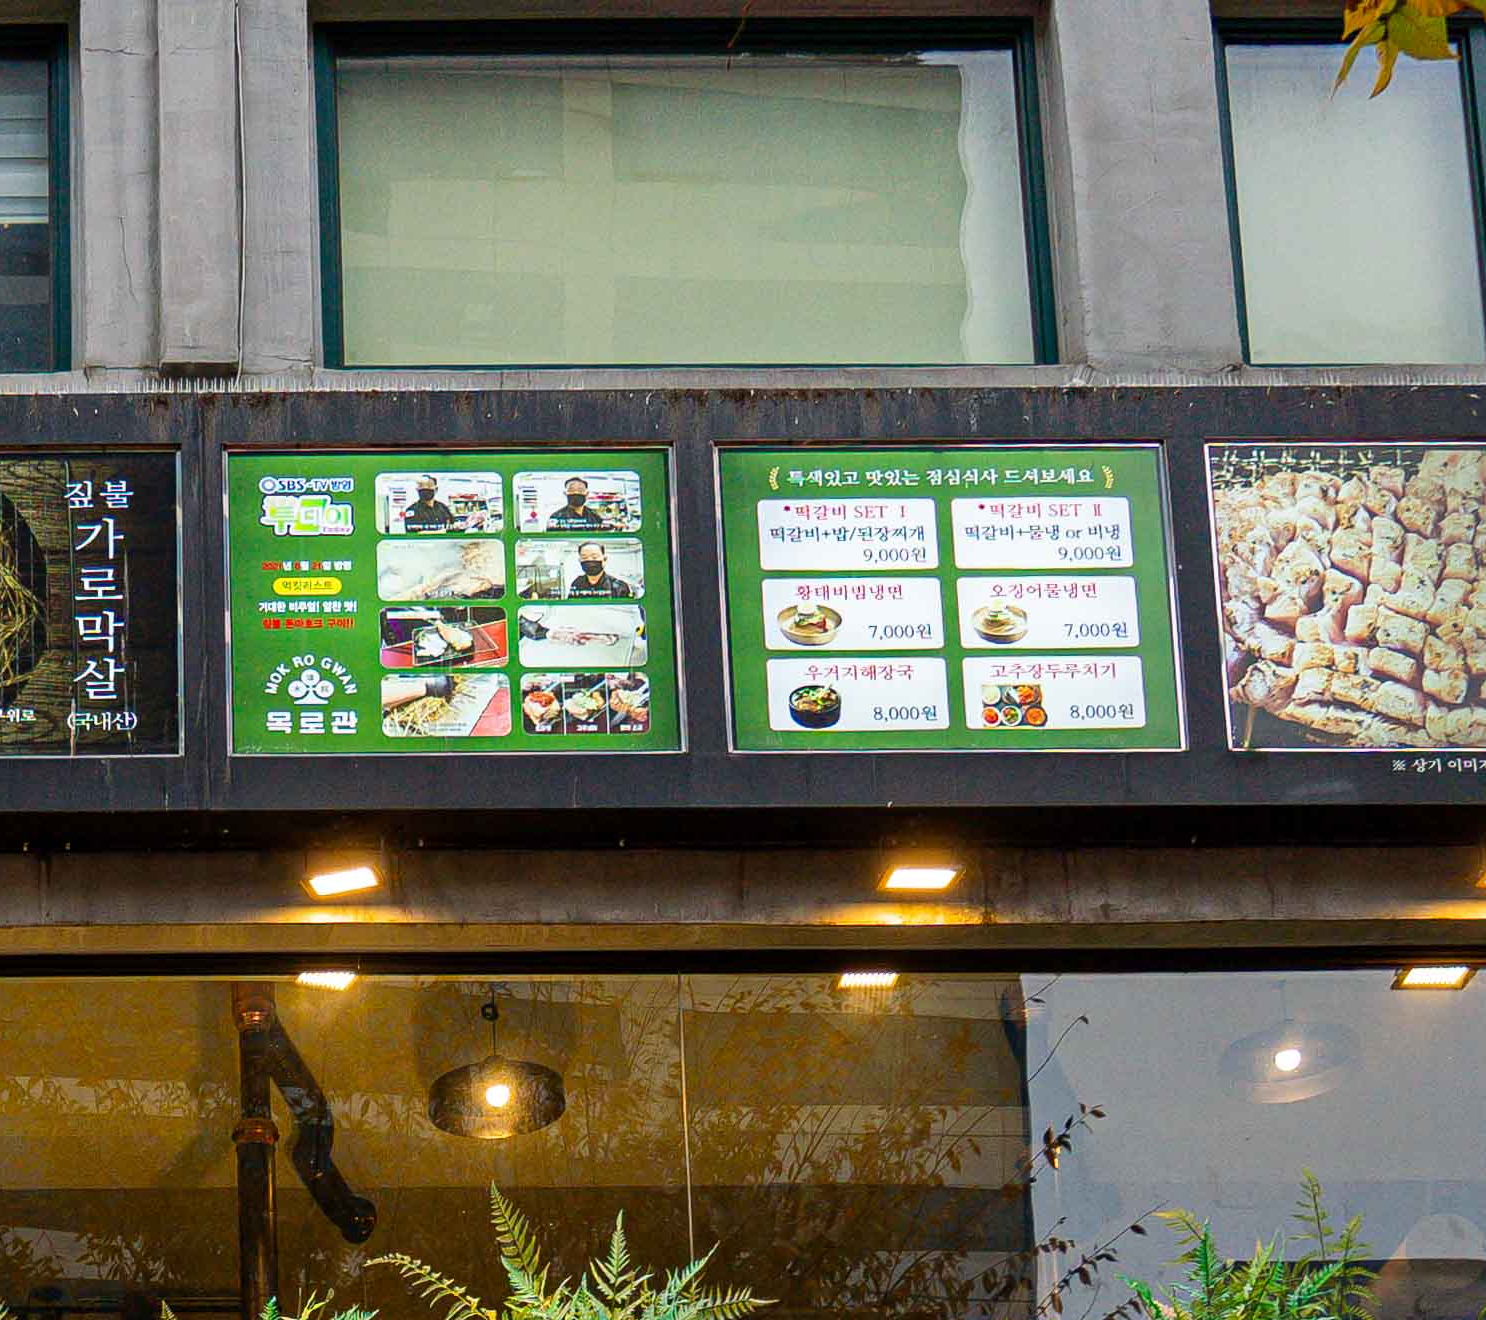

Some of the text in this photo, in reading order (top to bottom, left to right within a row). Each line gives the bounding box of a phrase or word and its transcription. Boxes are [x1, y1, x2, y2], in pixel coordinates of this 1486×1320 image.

[787, 467, 1095, 489] 특색있고 맛있는 점심식사 드셔보세요
[62, 479, 135, 509] 짚불
[794, 503, 886, 521] 떡갈비 SET
[990, 502, 1082, 519] 떡갈비 SET
[1065, 527, 1084, 539] or
[1087, 523, 1122, 541] 비냉
[862, 546, 927, 563] 9,000원
[1057, 545, 1123, 562] 9,000원
[73, 516, 126, 701] 가로막살
[867, 623, 933, 641] 7,000원
[1063, 621, 1129, 640] 7,000원
[804, 664, 915, 683] 우거지해장국
[989, 662, 1118, 681] 고추장두루치기
[66, 711, 139, 731] (국내산)
[872, 705, 938, 724] 8,000원
[1069, 703, 1135, 722] 8,000원
[265, 711, 358, 735] 목로관
[1411, 758, 1442, 773] 상기
